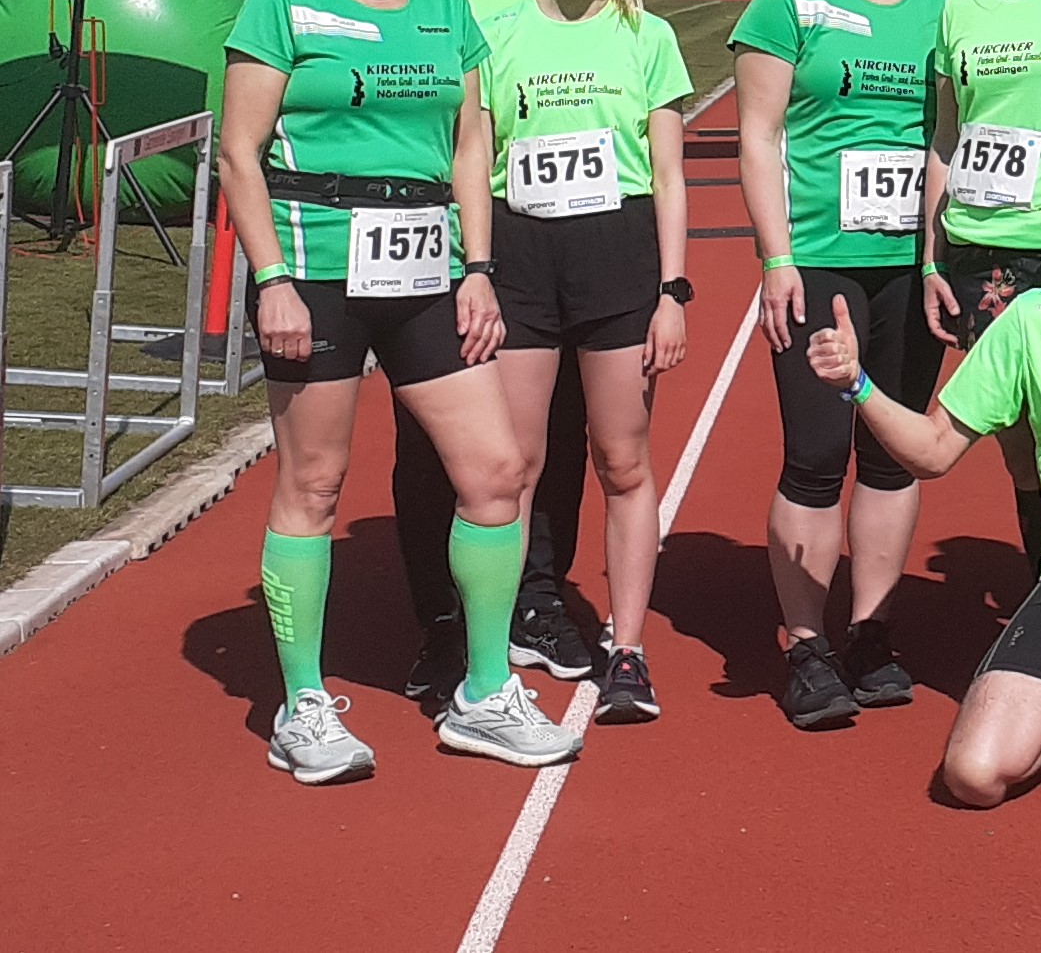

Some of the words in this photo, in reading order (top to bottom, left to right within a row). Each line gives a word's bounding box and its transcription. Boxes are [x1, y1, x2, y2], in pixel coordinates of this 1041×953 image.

[971, 42, 1033, 55] KIRCHNER
[366, 64, 434, 74] KIRCHNER
[855, 59, 916, 74] KIRCHNER
[976, 66, 1029, 76] Nördlingen
[528, 72, 594, 87] KIRCHNER
[377, 89, 437, 98] Nördlingen
[537, 98, 593, 108] Nördlingen
[961, 139, 1027, 177] 1578
[519, 147, 604, 185] 1575
[366, 225, 442, 260] 1573
